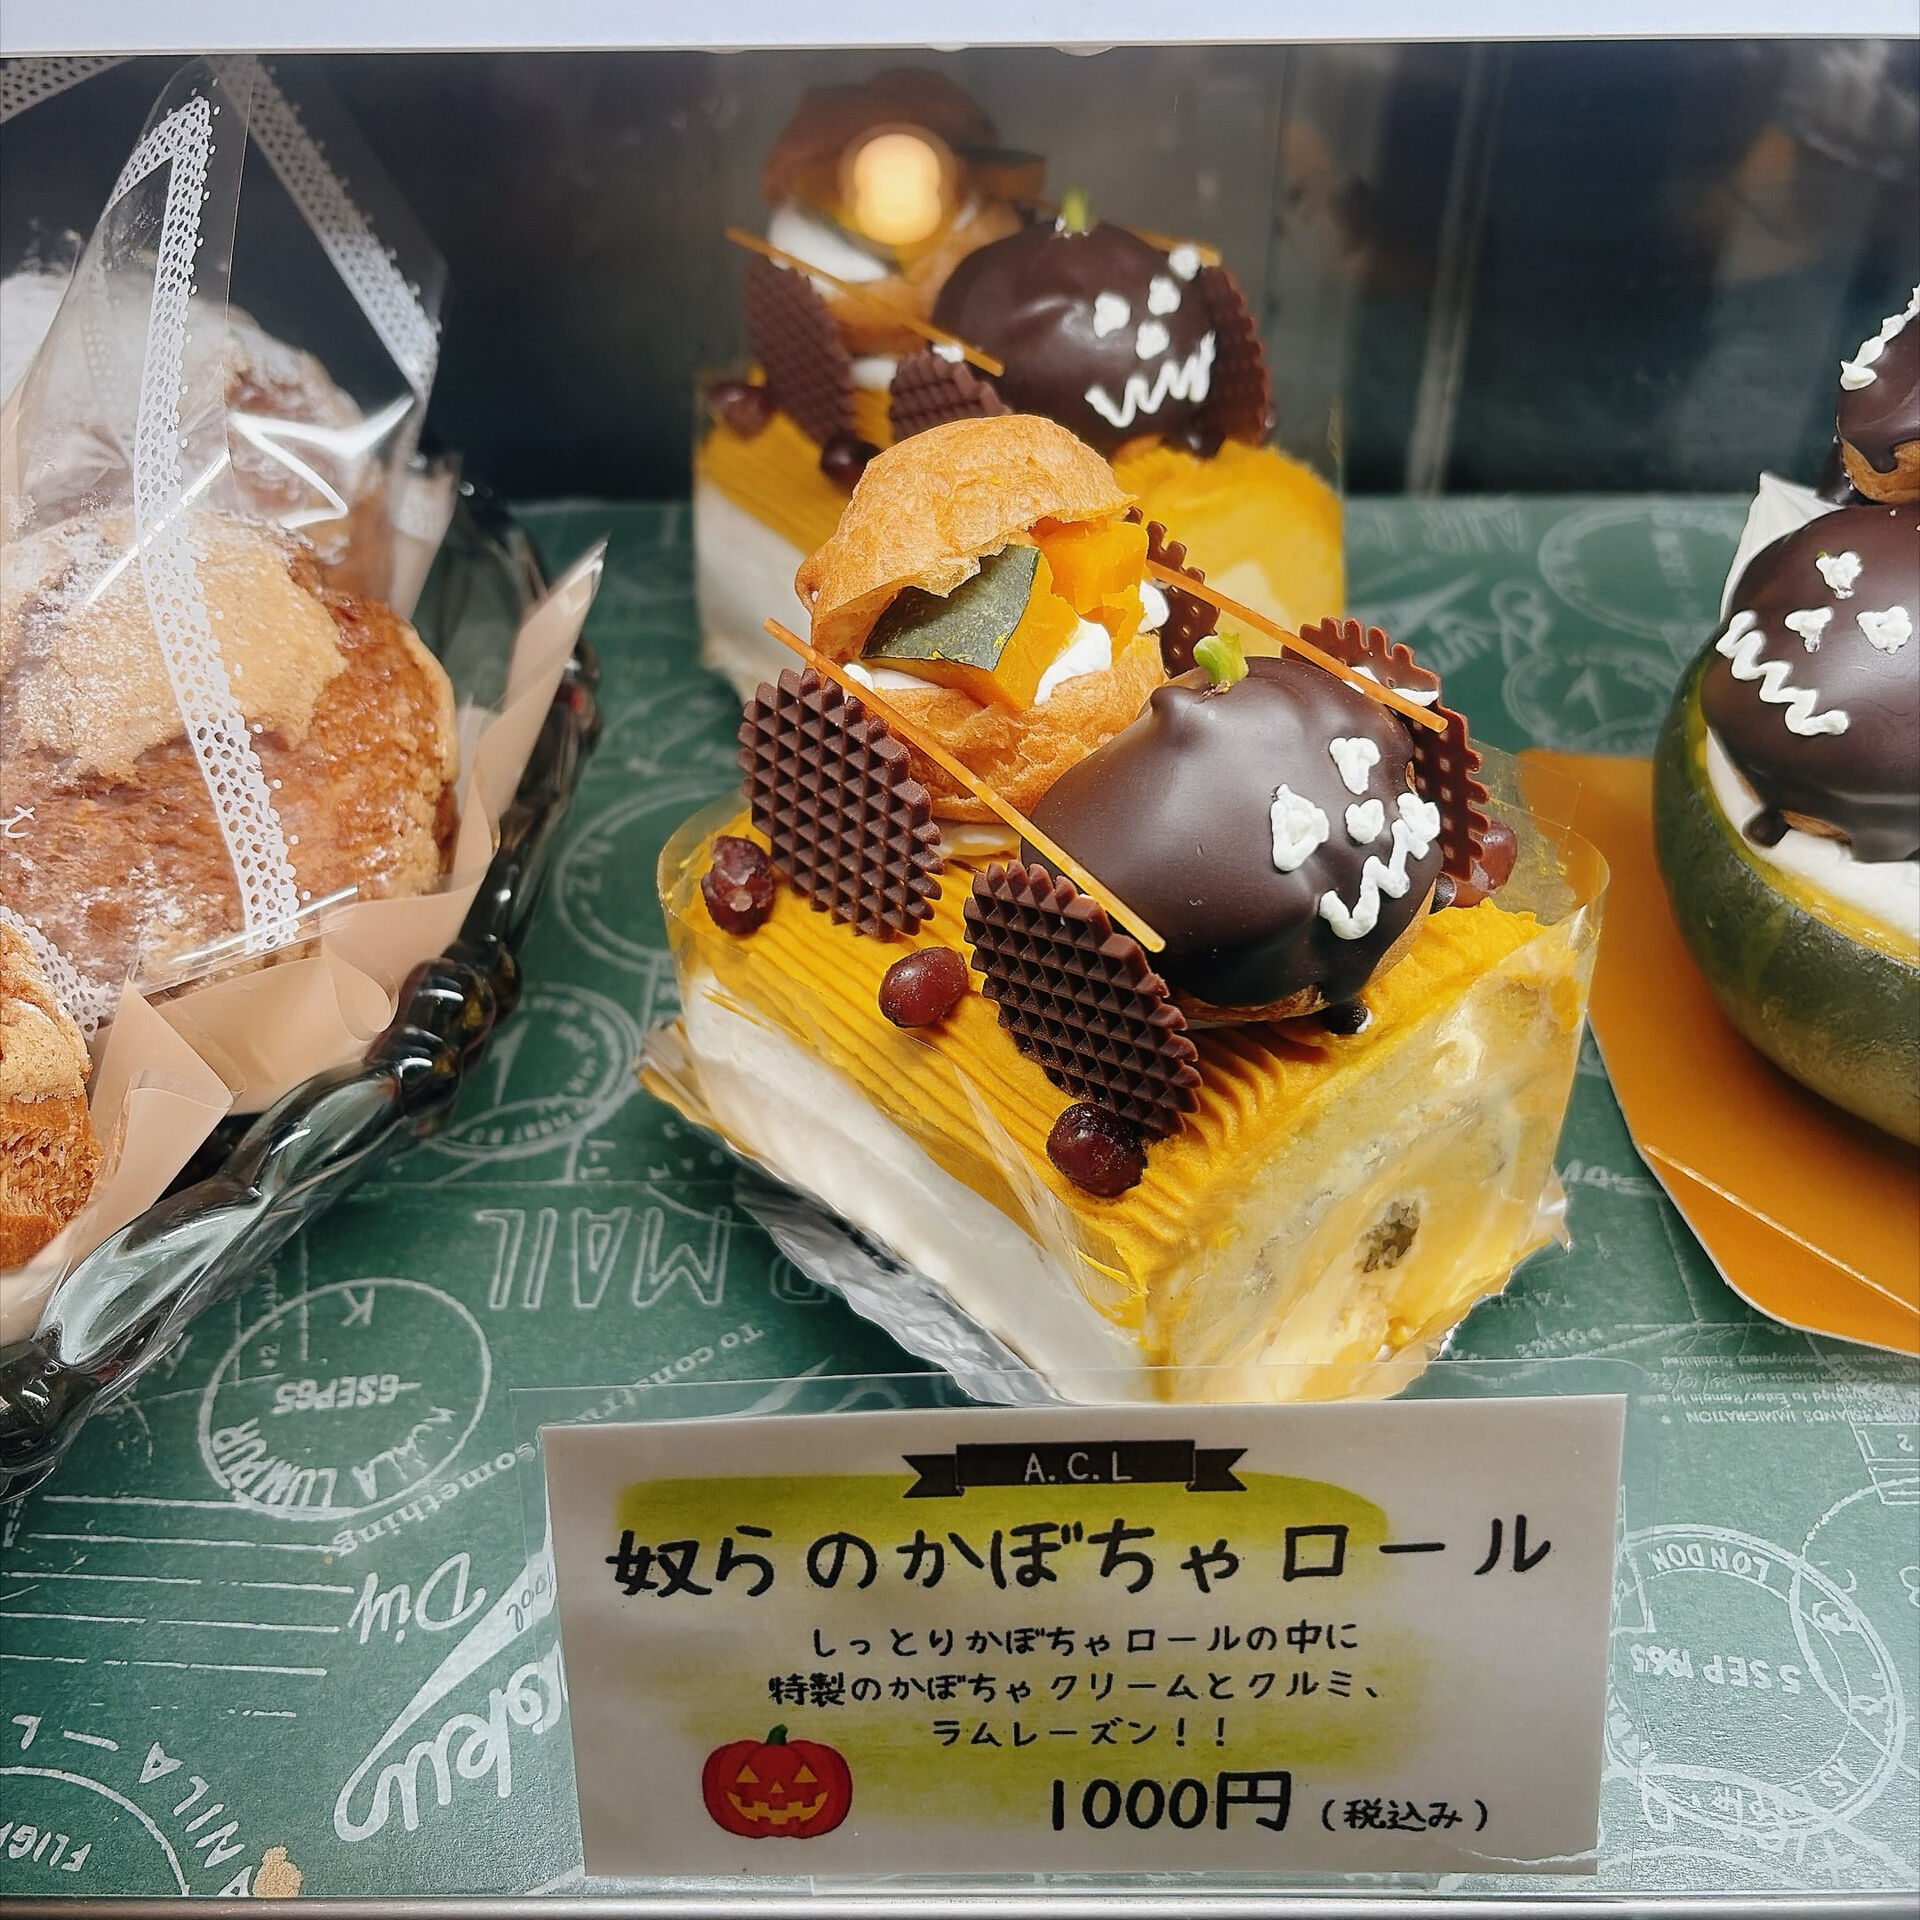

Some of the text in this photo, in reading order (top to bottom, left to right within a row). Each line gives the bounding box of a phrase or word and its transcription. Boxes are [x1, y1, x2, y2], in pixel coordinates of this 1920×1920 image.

[474, 1206, 732, 1311] MAIL
[330, 1321, 766, 1558] To constru something
[1685, 1409, 1797, 1424] IMMIGRATION
[210, 1416, 338, 1509] LUMPUR
[1023, 1451, 1132, 1484] A.C.L
[606, 1514, 1552, 1597] 奴らのかぼちゃロール
[1647, 1542, 1771, 1578] LONDON
[347, 1552, 486, 1644] Diy
[813, 1619, 1359, 1657] しっとりかぼちゃロールの中に
[768, 1670, 1379, 1707] 特製のかぼちゃクリームとクルミ、
[1629, 1643, 1801, 1694] 5 SEP 1965
[932, 1717, 1227, 1748] ラムレーズン！！
[138, 1740, 253, 1896] ANILA
[1051, 1770, 1488, 1833] 1000円 （税込み）
